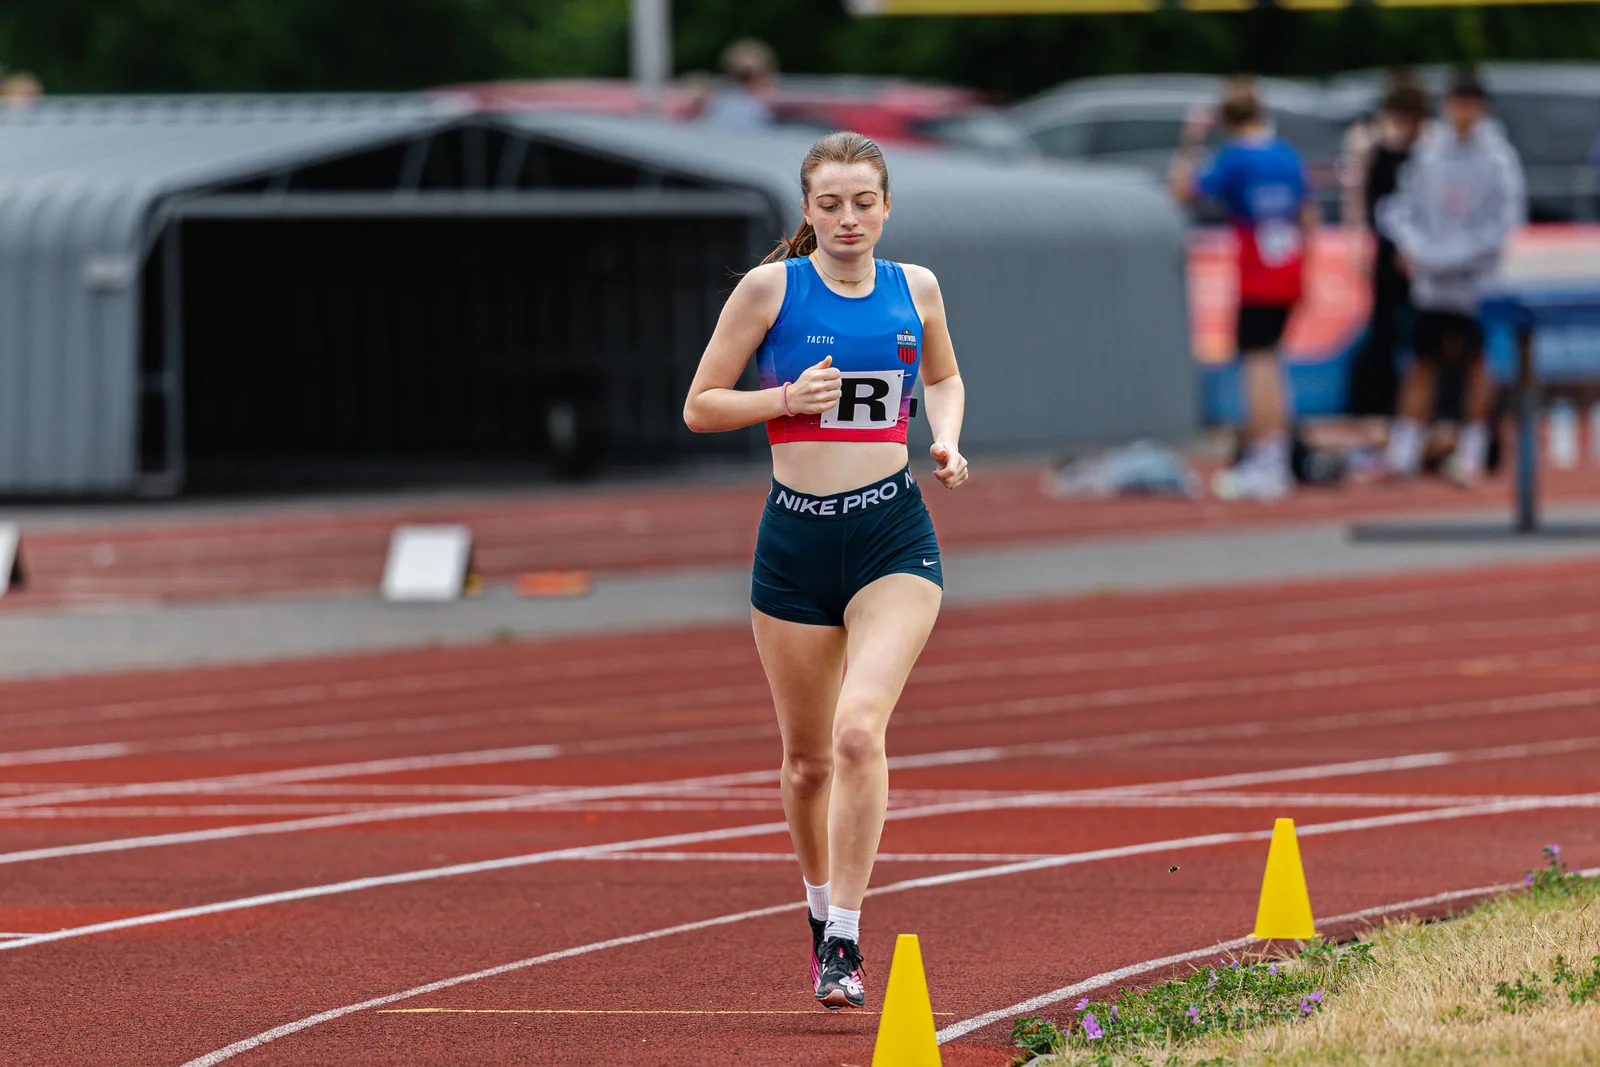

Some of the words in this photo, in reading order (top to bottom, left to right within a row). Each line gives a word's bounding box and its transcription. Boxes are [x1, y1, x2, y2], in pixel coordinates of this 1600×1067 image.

[806, 335, 835, 345] TACTIC
[837, 377, 890, 422] R
[775, 490, 838, 516] NIKE
[842, 481, 898, 514] PRO
